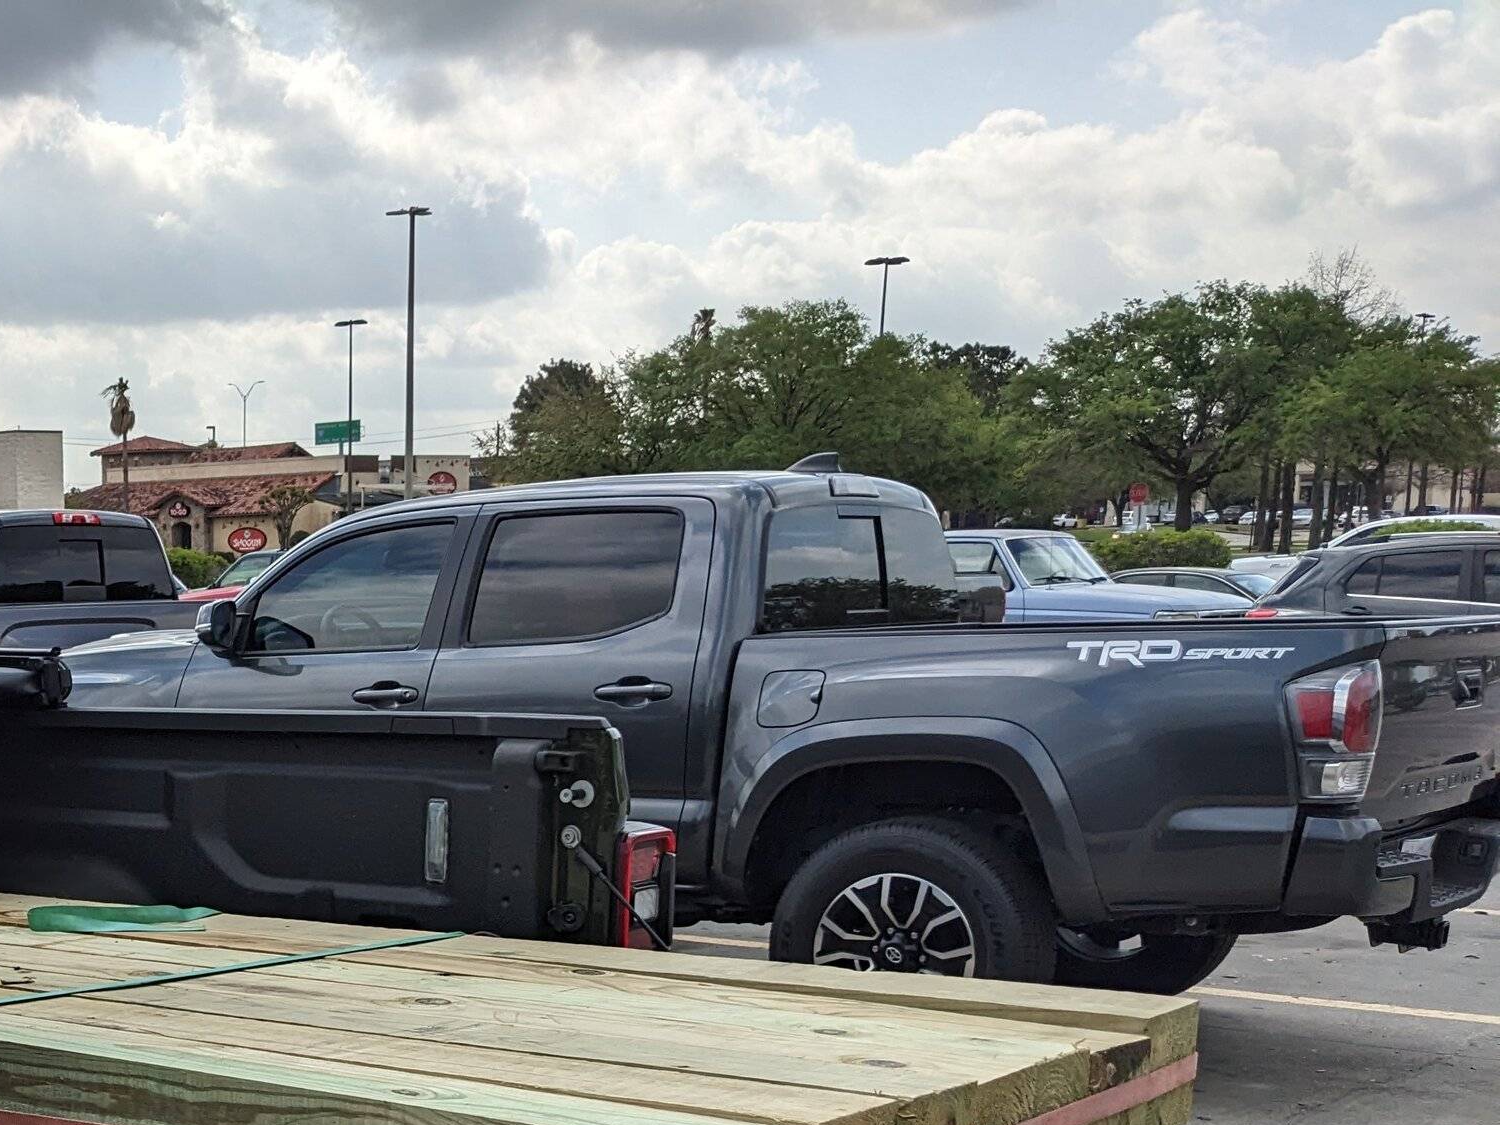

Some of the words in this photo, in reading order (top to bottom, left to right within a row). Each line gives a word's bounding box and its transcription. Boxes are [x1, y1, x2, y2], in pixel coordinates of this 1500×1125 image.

[1066, 639, 1184, 668] TRD
[1182, 647, 1296, 660] SPORT
[1400, 765, 1482, 799] TACOMA
